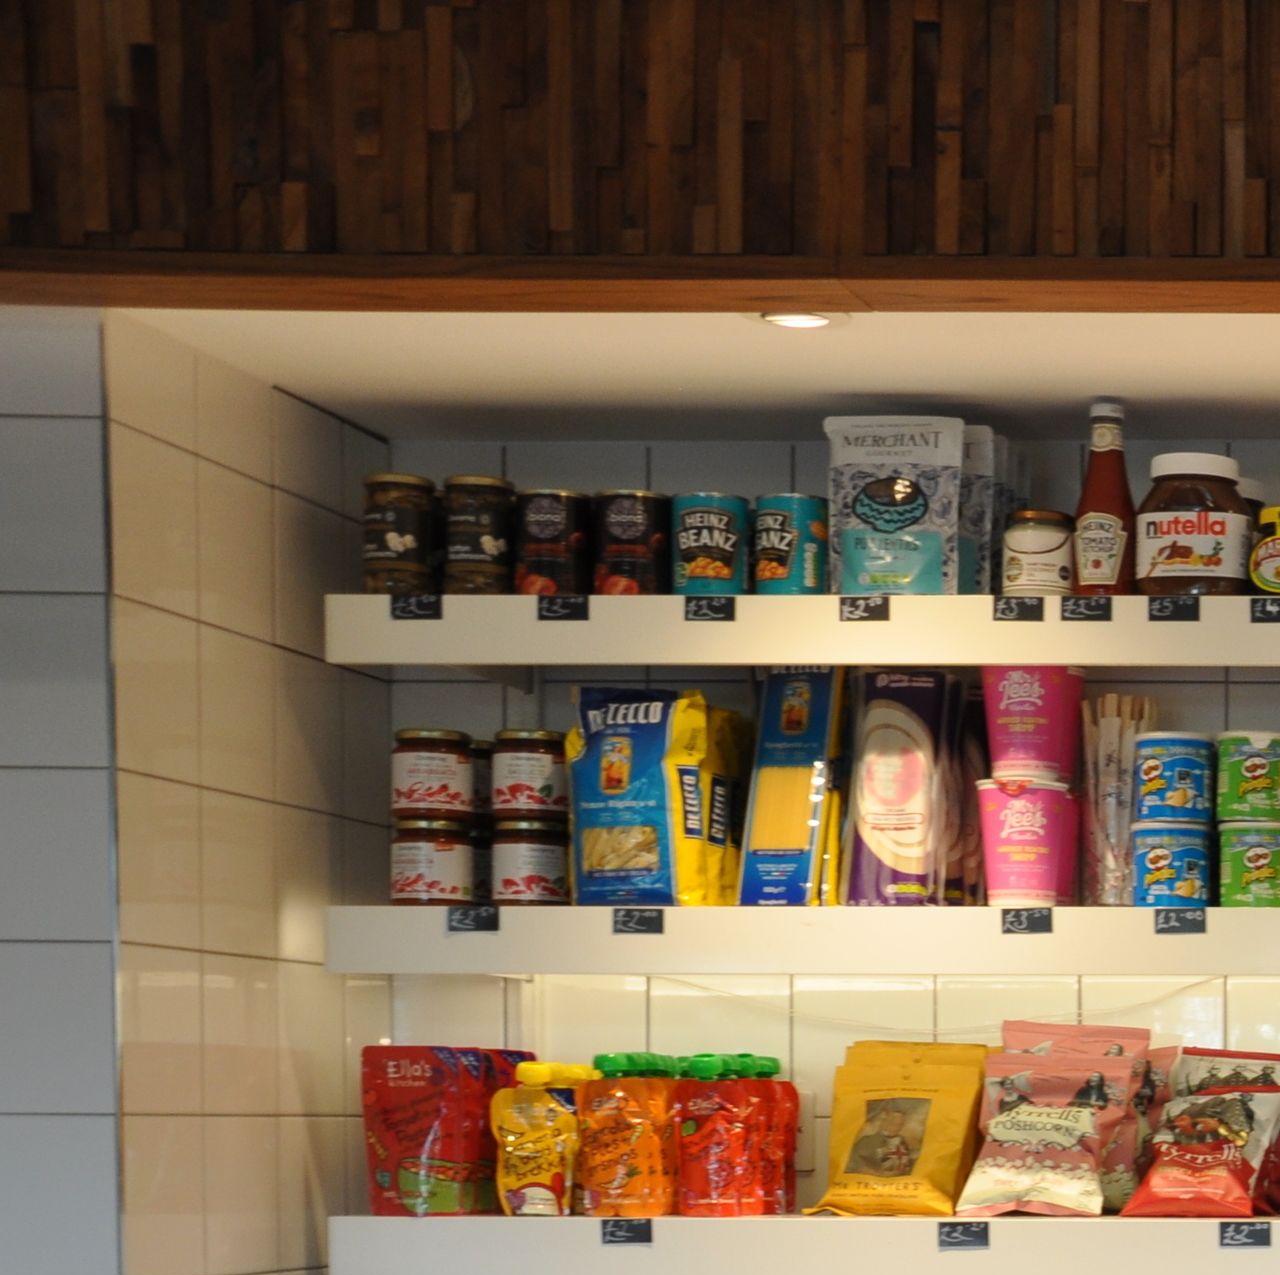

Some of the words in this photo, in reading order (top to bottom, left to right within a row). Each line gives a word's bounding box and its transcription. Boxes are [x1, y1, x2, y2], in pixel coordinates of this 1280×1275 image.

[843, 430, 940, 450] MERCHANT
[684, 508, 730, 530] HEINZ
[1146, 510, 1227, 537] nutella
[679, 527, 739, 552] BEANZ
[387, 1060, 433, 1078] Ella's
